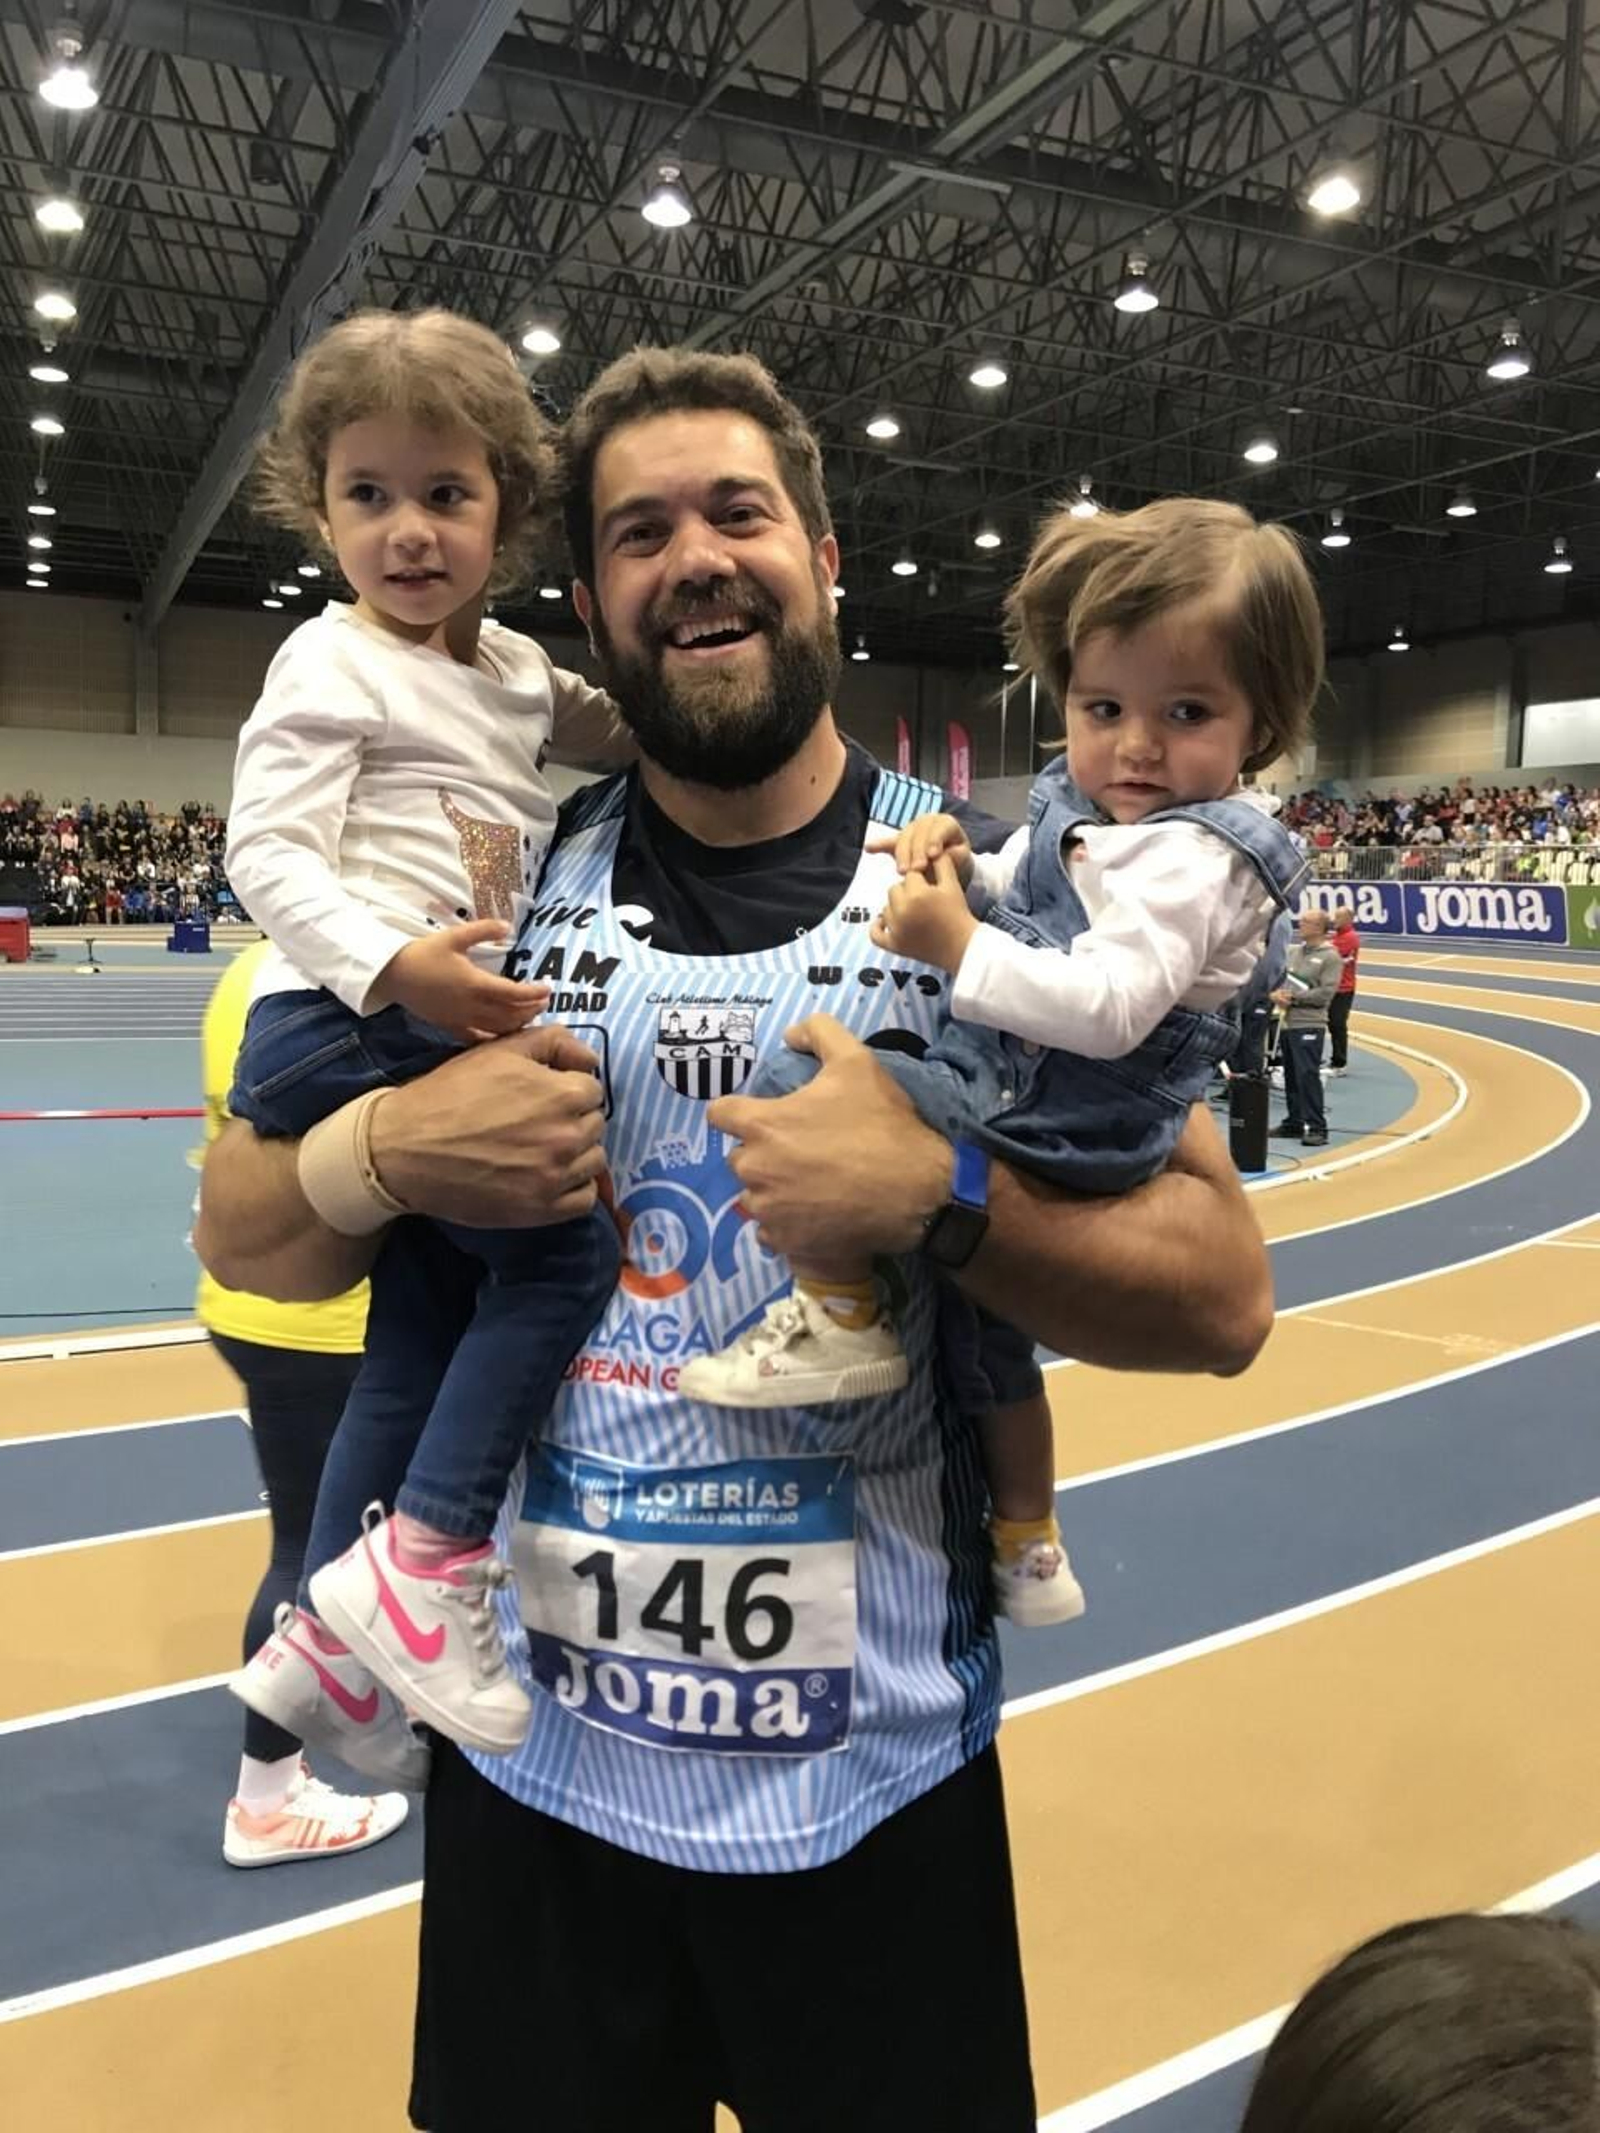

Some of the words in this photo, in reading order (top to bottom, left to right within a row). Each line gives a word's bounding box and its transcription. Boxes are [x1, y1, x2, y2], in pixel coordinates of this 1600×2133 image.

[1416, 886, 1552, 933] Joma
[502, 946, 622, 989] CAM
[668, 1043, 742, 1059] CAM
[636, 1477, 799, 1509] LOTERÍAS
[572, 1550, 793, 1661] 146
